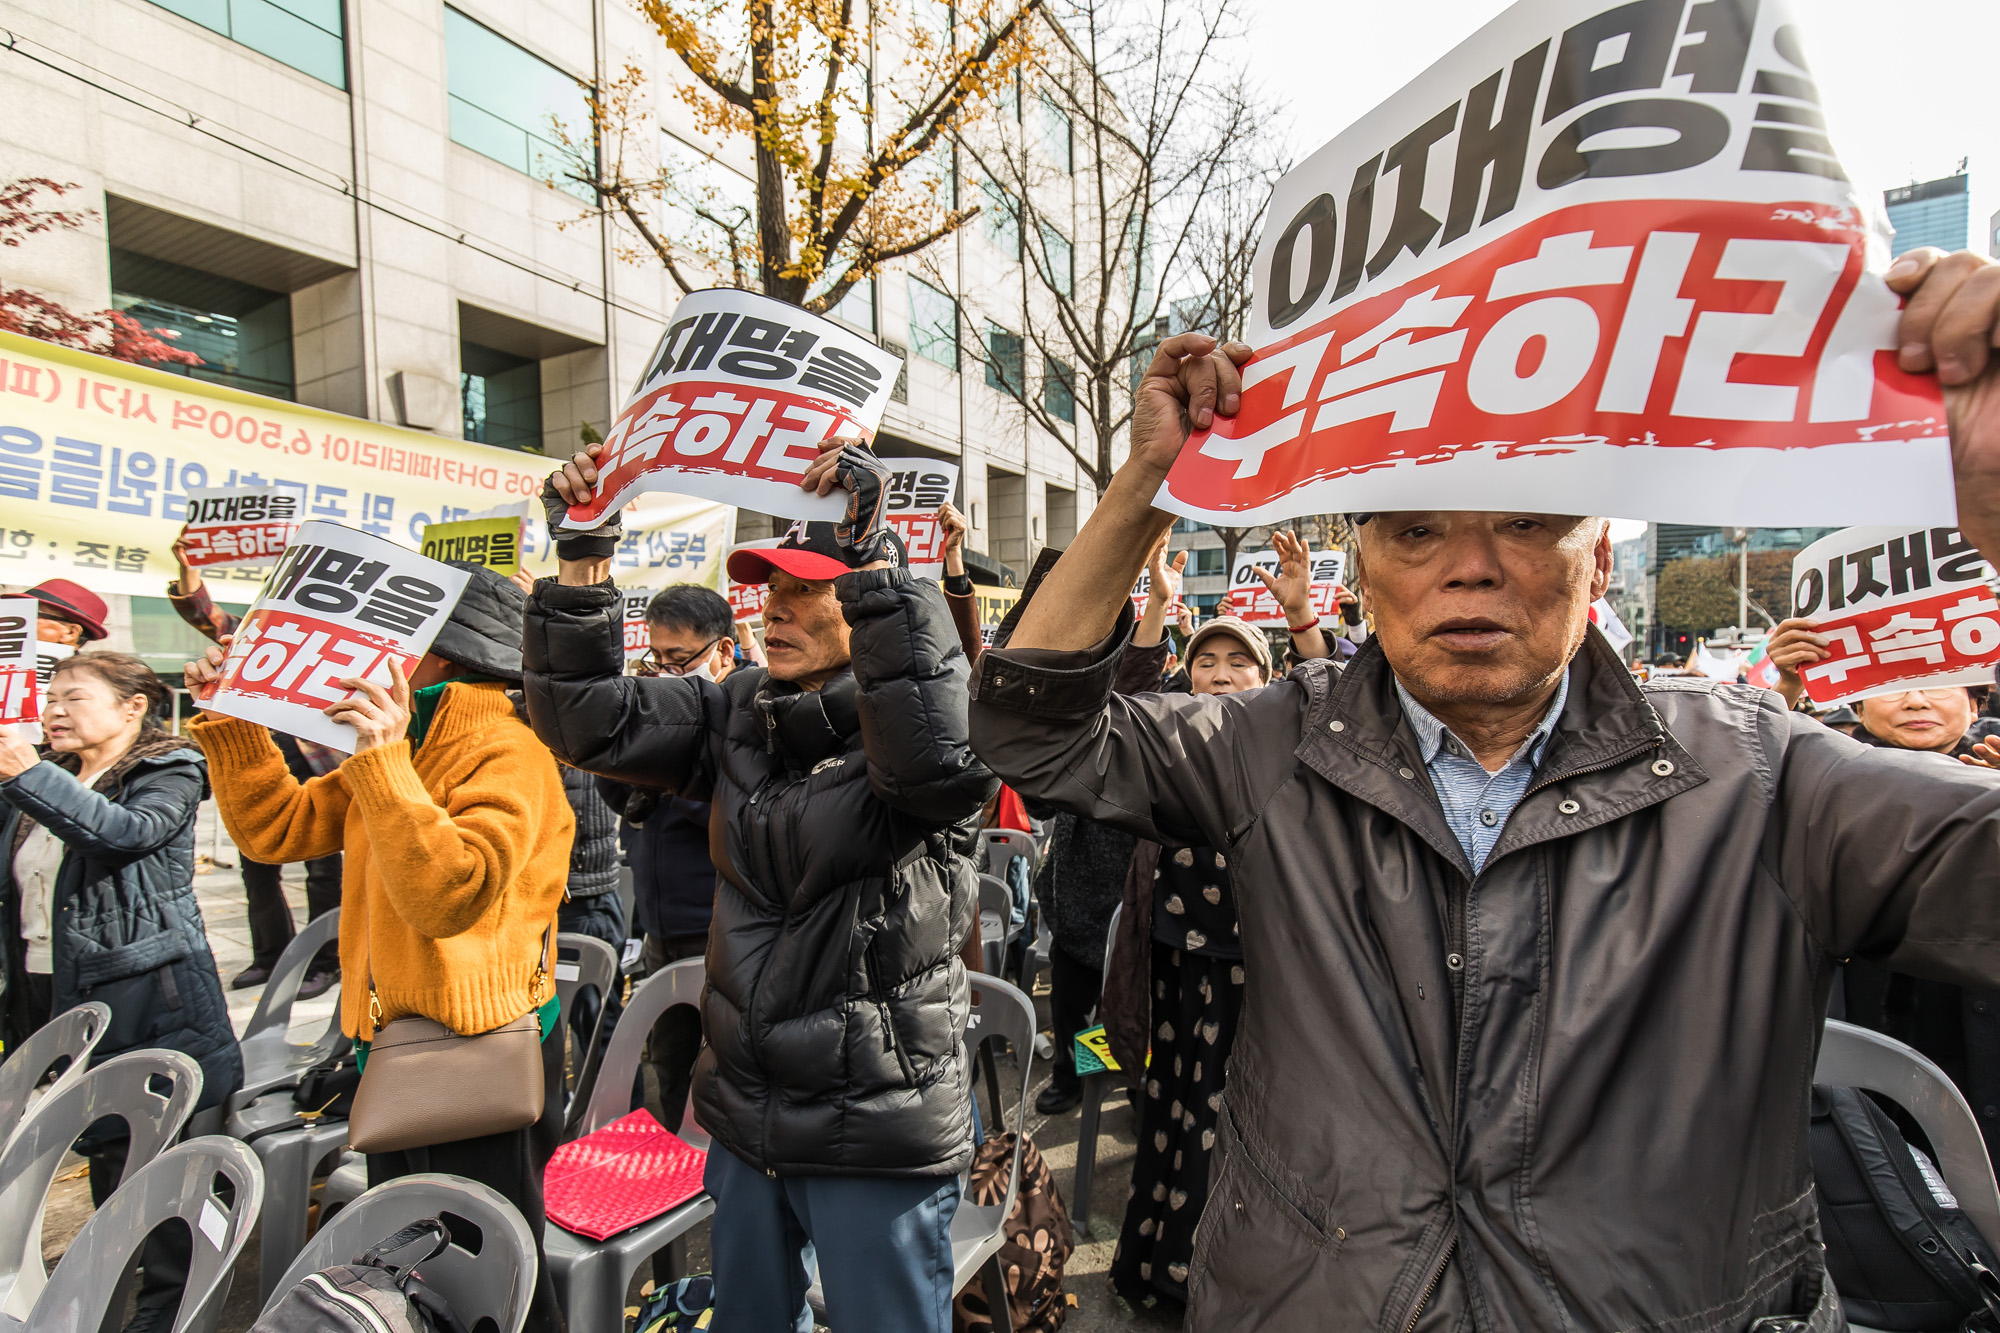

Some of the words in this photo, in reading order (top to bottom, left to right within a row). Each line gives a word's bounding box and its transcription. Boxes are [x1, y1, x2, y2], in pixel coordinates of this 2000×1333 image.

[1268, 0, 1848, 329] 이재명을
[634, 312, 882, 408] 재명을
[1200, 231, 1897, 480] 구속하라
[187, 494, 296, 523] 이재명을
[1232, 587, 1336, 617] 구속라
